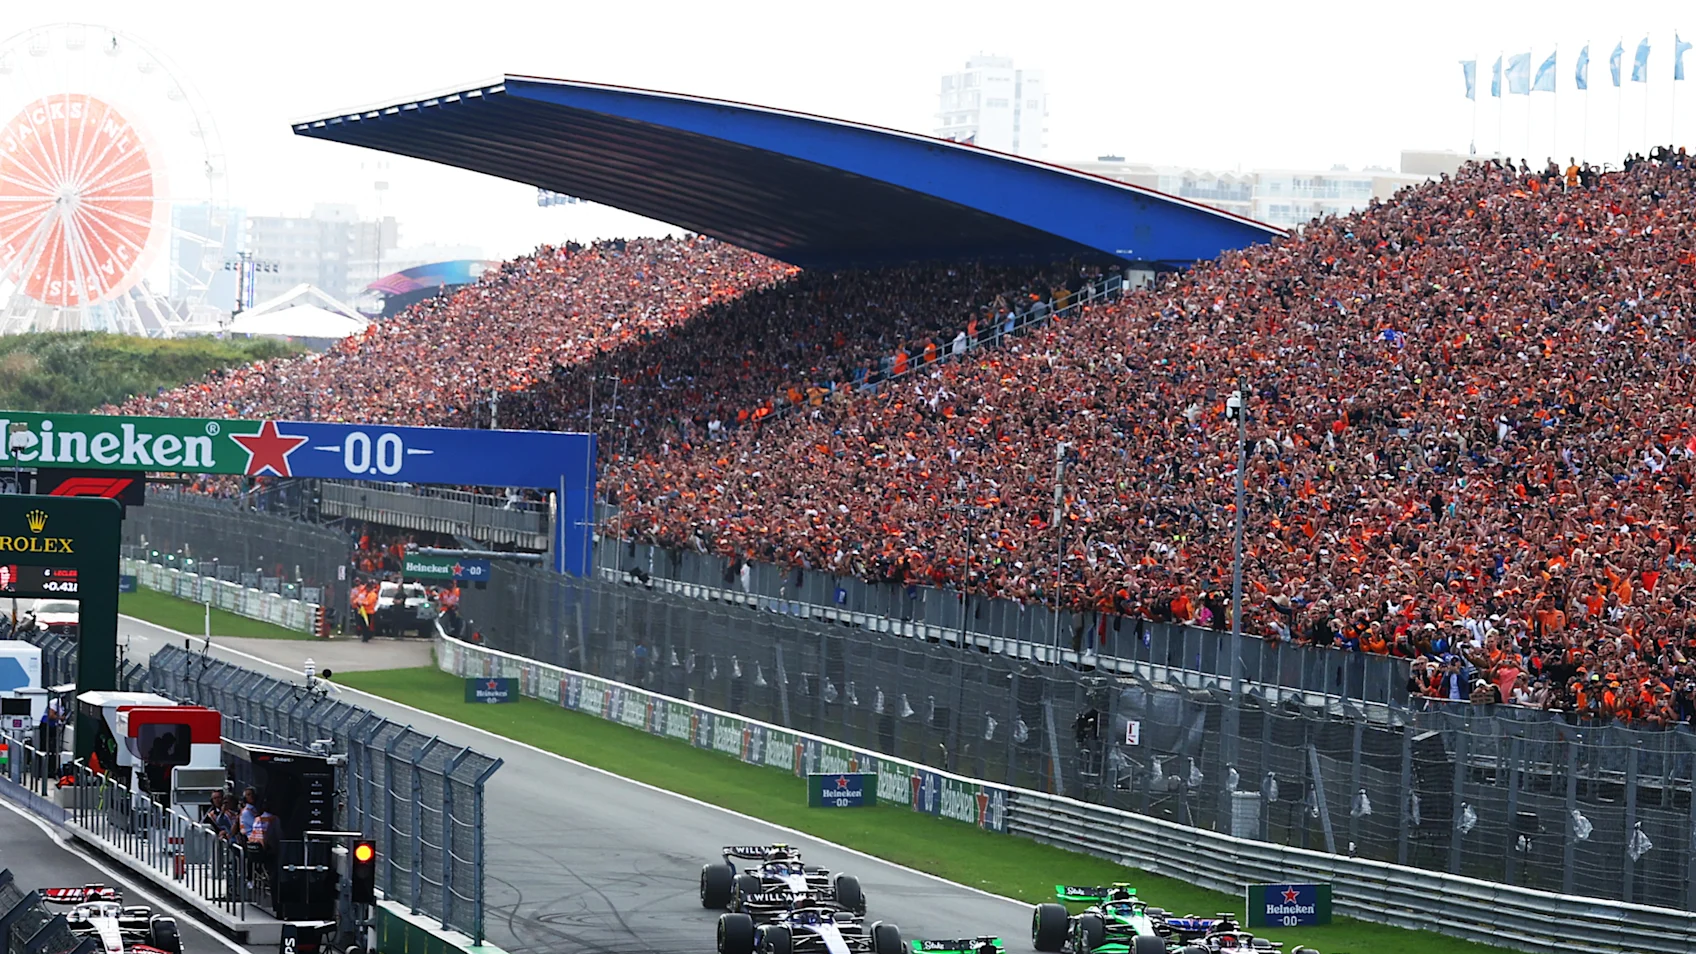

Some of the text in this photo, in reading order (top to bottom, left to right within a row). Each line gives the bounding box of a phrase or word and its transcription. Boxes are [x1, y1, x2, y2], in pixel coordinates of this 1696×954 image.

[344, 433, 403, 475] 0.0
[0, 536, 74, 553] ROLEX
[823, 789, 862, 798] Heineken
[1266, 903, 1315, 916] Heineken
